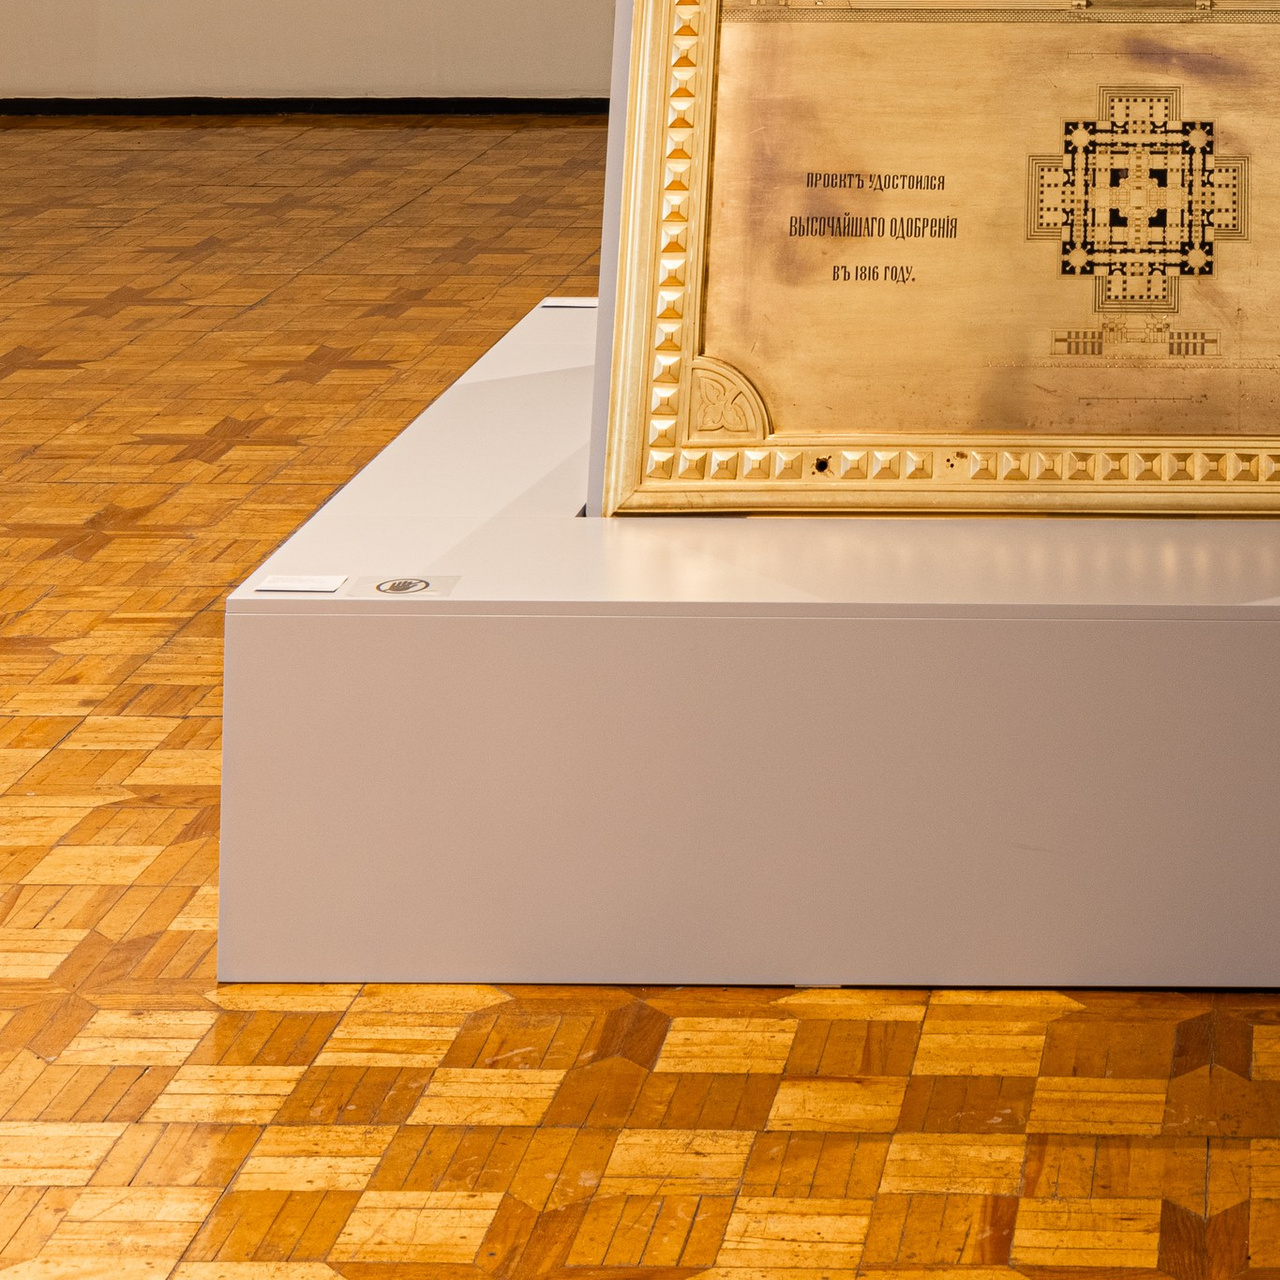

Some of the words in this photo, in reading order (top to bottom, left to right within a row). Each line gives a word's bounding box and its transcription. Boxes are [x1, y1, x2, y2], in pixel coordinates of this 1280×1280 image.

[806, 172, 864, 189] ПРОЕКТЪ
[869, 174, 946, 192] УДОСТОИЛСЯ
[789, 212, 885, 238] ВЫСОЧАЙШАГО
[832, 265, 851, 282] ВЪ
[855, 265, 879, 282] 1816
[883, 265, 916, 284] ГОДУ.
